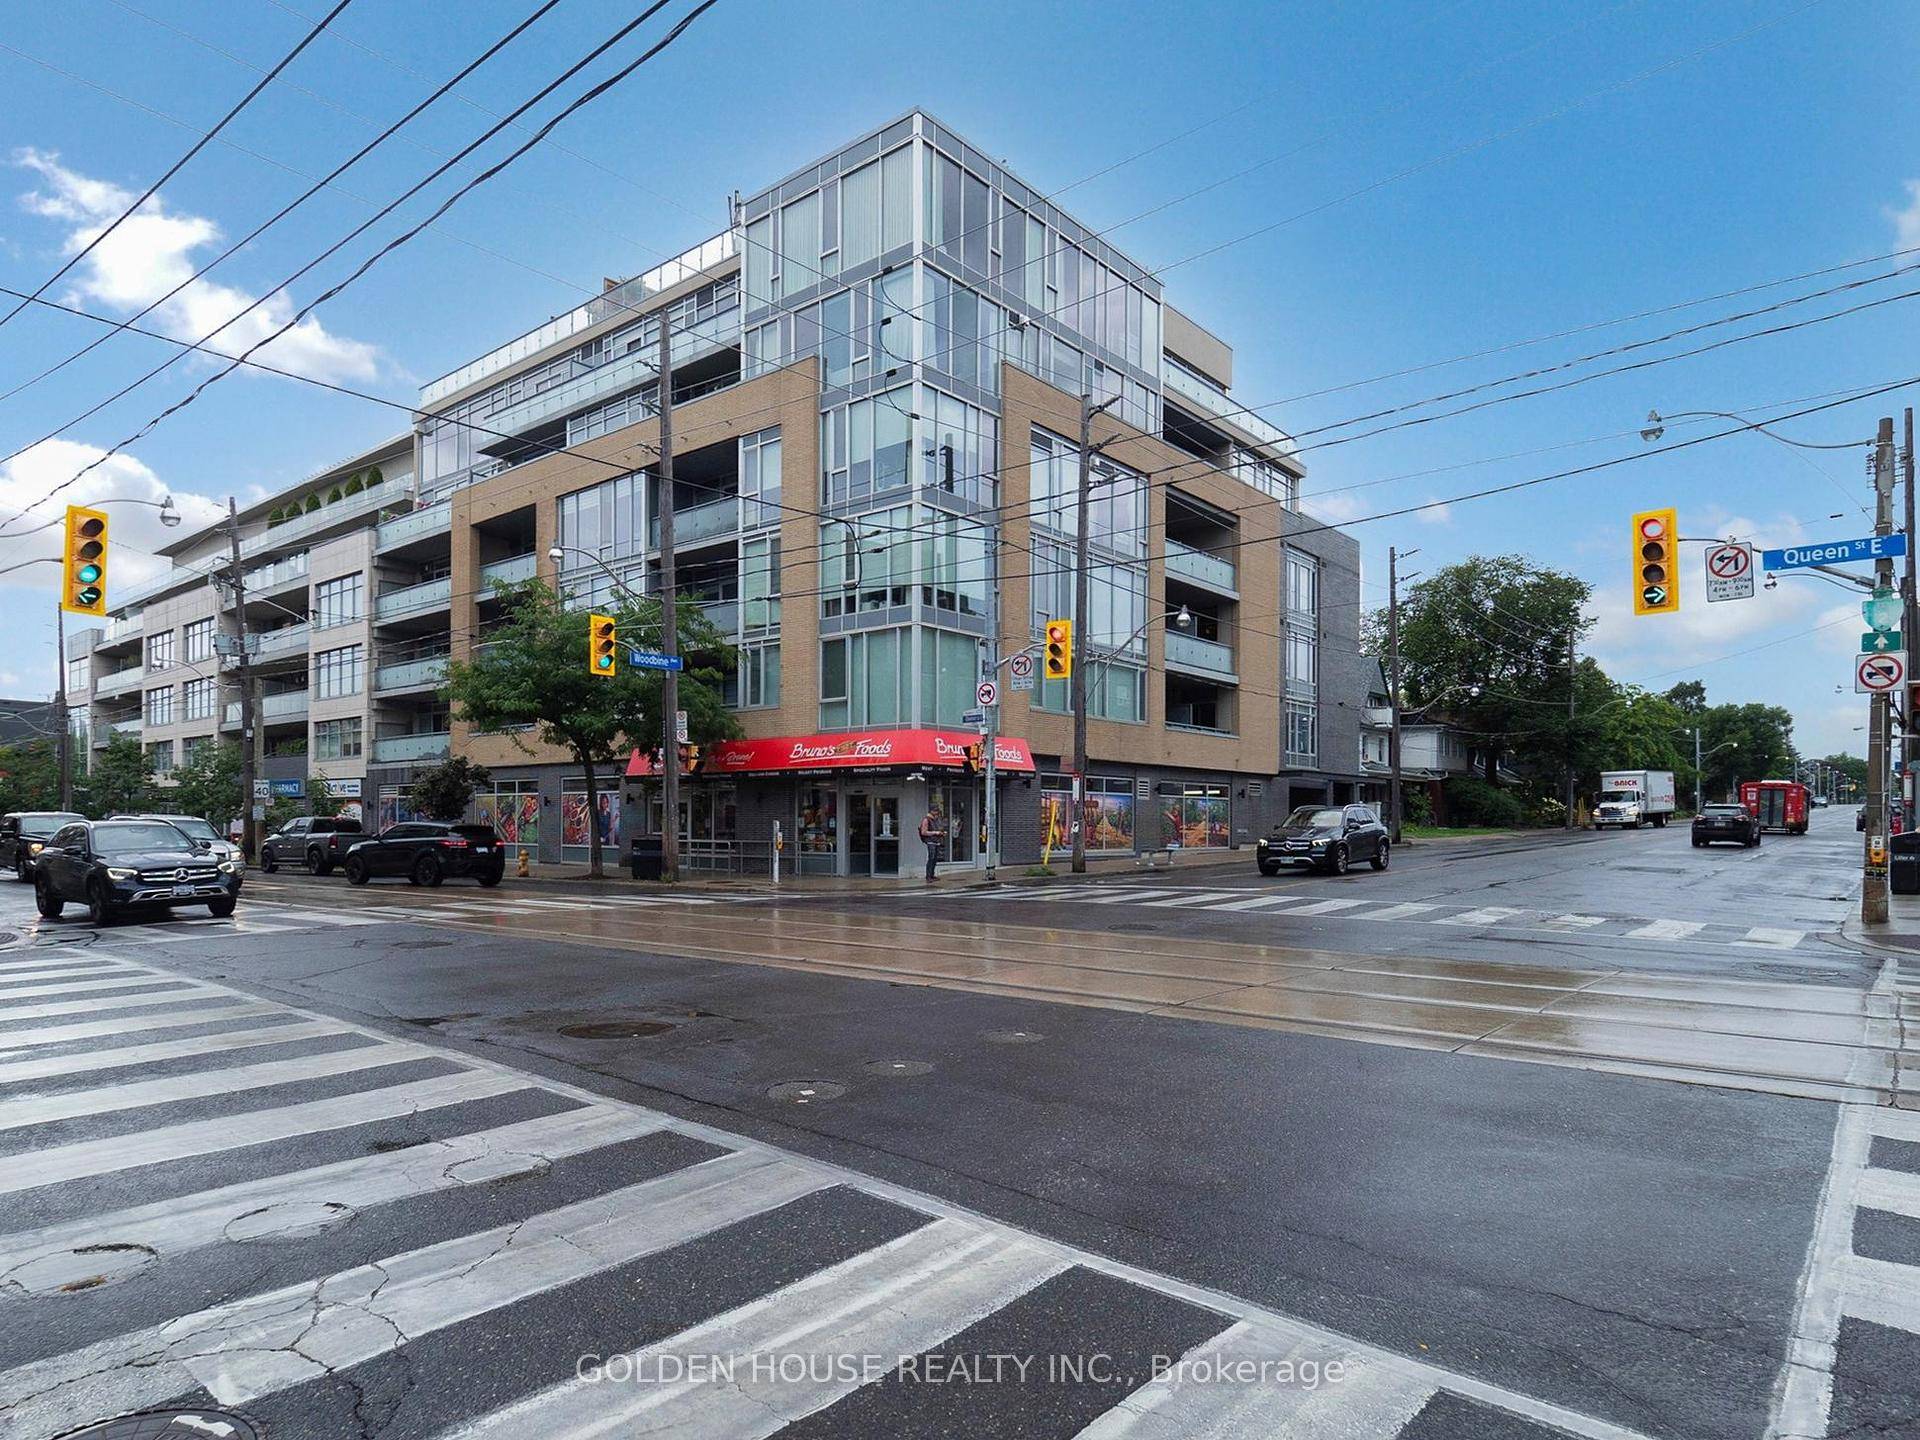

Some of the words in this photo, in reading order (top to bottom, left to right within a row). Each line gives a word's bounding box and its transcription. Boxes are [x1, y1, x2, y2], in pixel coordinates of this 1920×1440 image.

[1783, 545, 1850, 565] Queen
[1855, 540, 1866, 550] St
[1870, 538, 1883, 555] E
[634, 653, 670, 667] Woodbine
[789, 743, 836, 759] Bruno's
[854, 738, 893, 756] Foods
[935, 737, 965, 755] Brun
[1614, 779, 1638, 787] BRICK
[254, 787, 269, 796] 40
